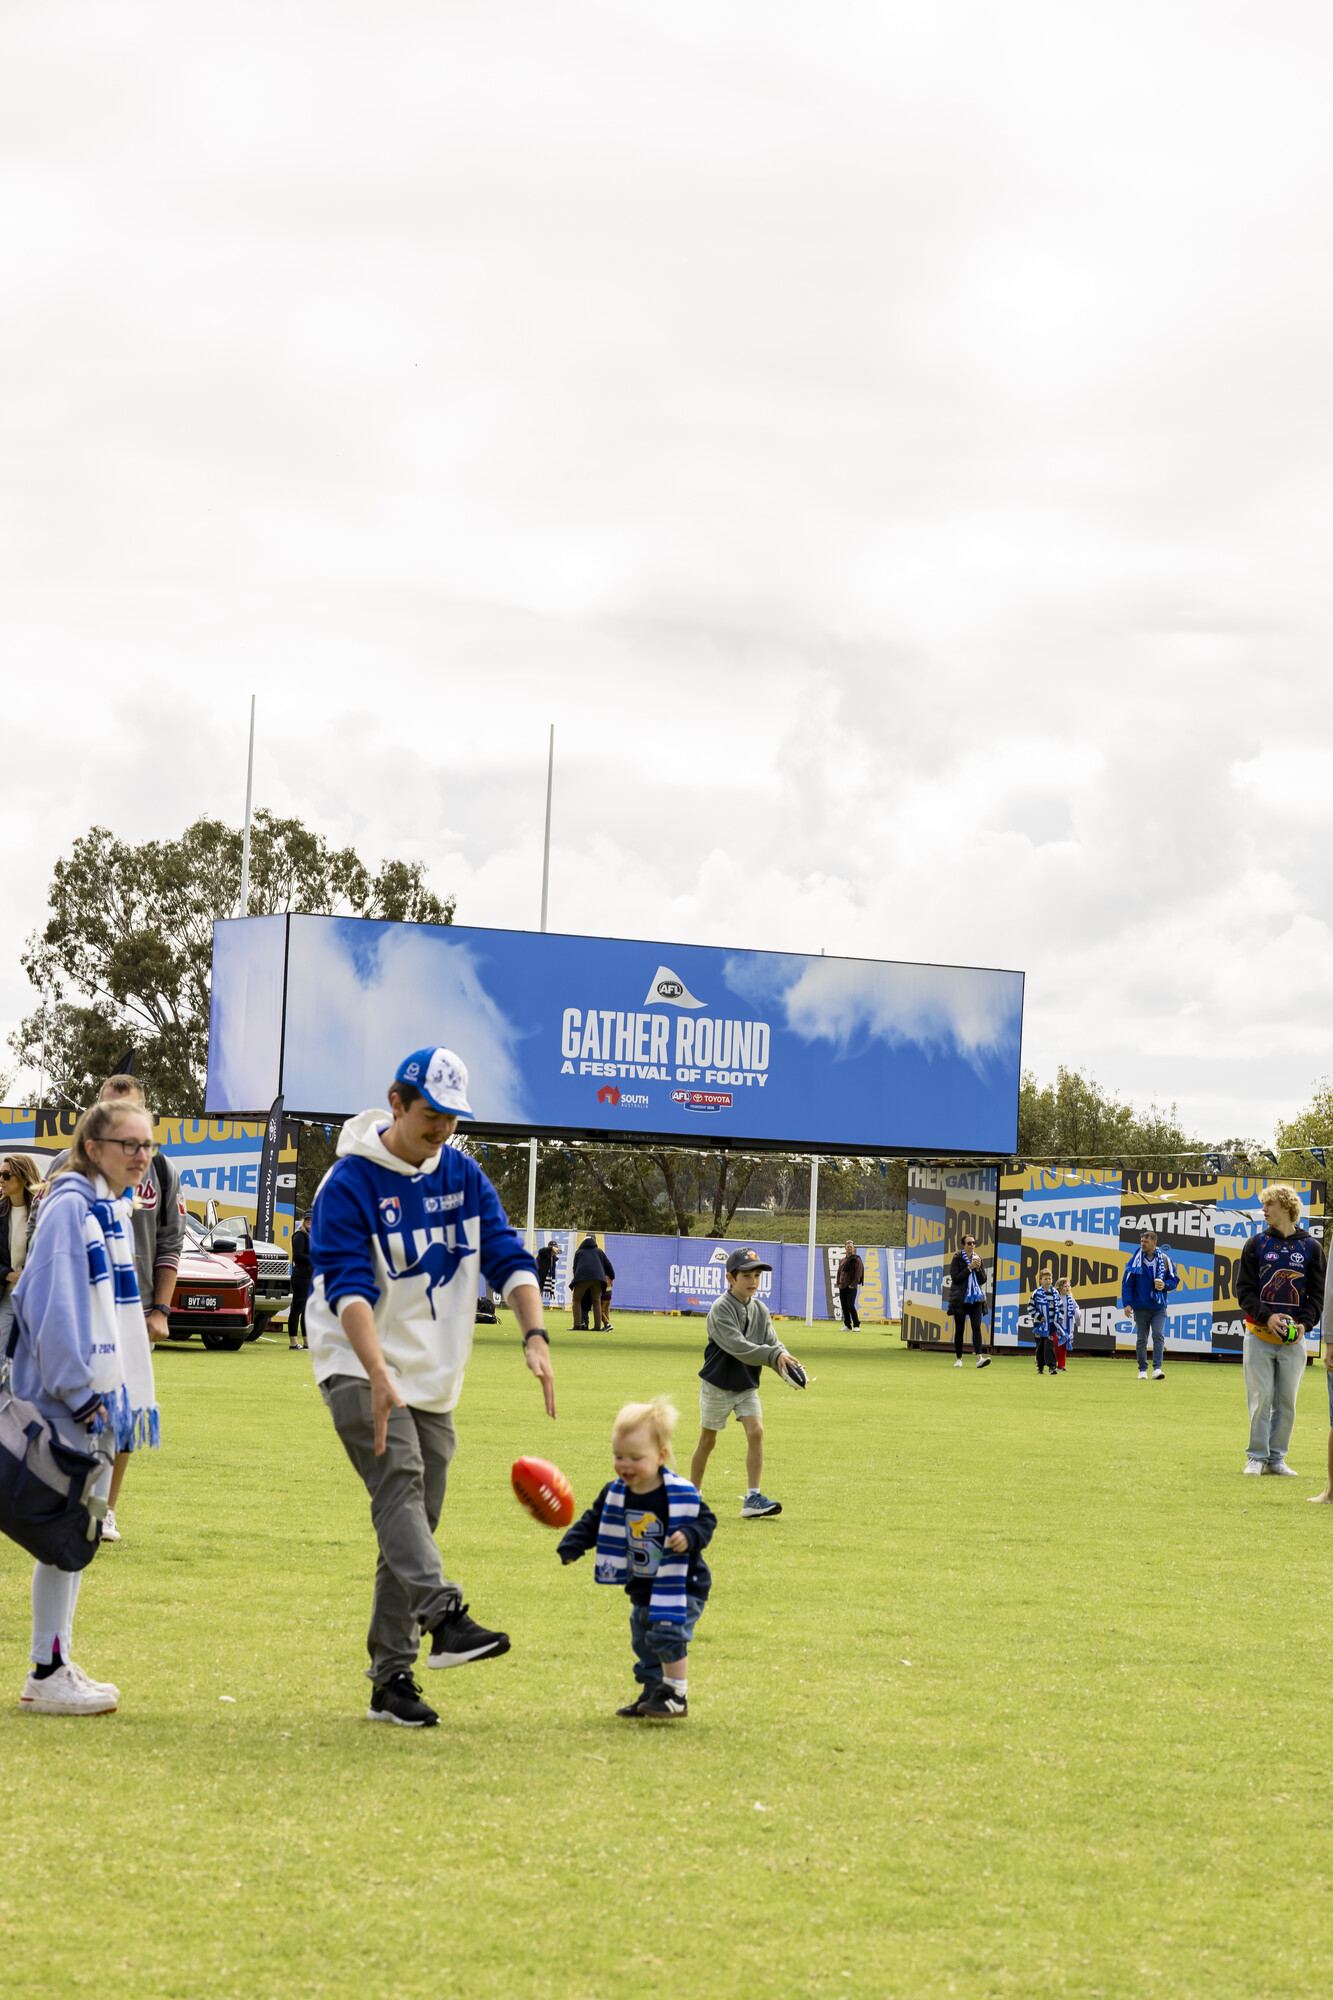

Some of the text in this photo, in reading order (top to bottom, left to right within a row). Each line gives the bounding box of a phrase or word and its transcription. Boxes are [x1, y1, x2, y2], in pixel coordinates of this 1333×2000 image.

[659, 984, 681, 995] AFL
[561, 1007, 771, 1071] GATHER ROUND
[560, 1060, 769, 1087] A FESTIVAL OF FOOTY
[620, 1094, 649, 1105] SOUTH
[671, 1093, 731, 1104] AFL TOYOTA
[180, 1163, 262, 1194] ATHE
[264, 1188, 272, 1223] Valley
[1021, 1206, 1121, 1236] GATHER
[1120, 1208, 1216, 1238] GATHER
[669, 1264, 722, 1289] GATHER
[1020, 1245, 1118, 1293] ROUND
[679, 1287, 722, 1296] FESTIVAL
[857, 1248, 884, 1321] ROUND
[188, 1297, 201, 1306] BVT
[98, 1344, 116, 1354] 2024
